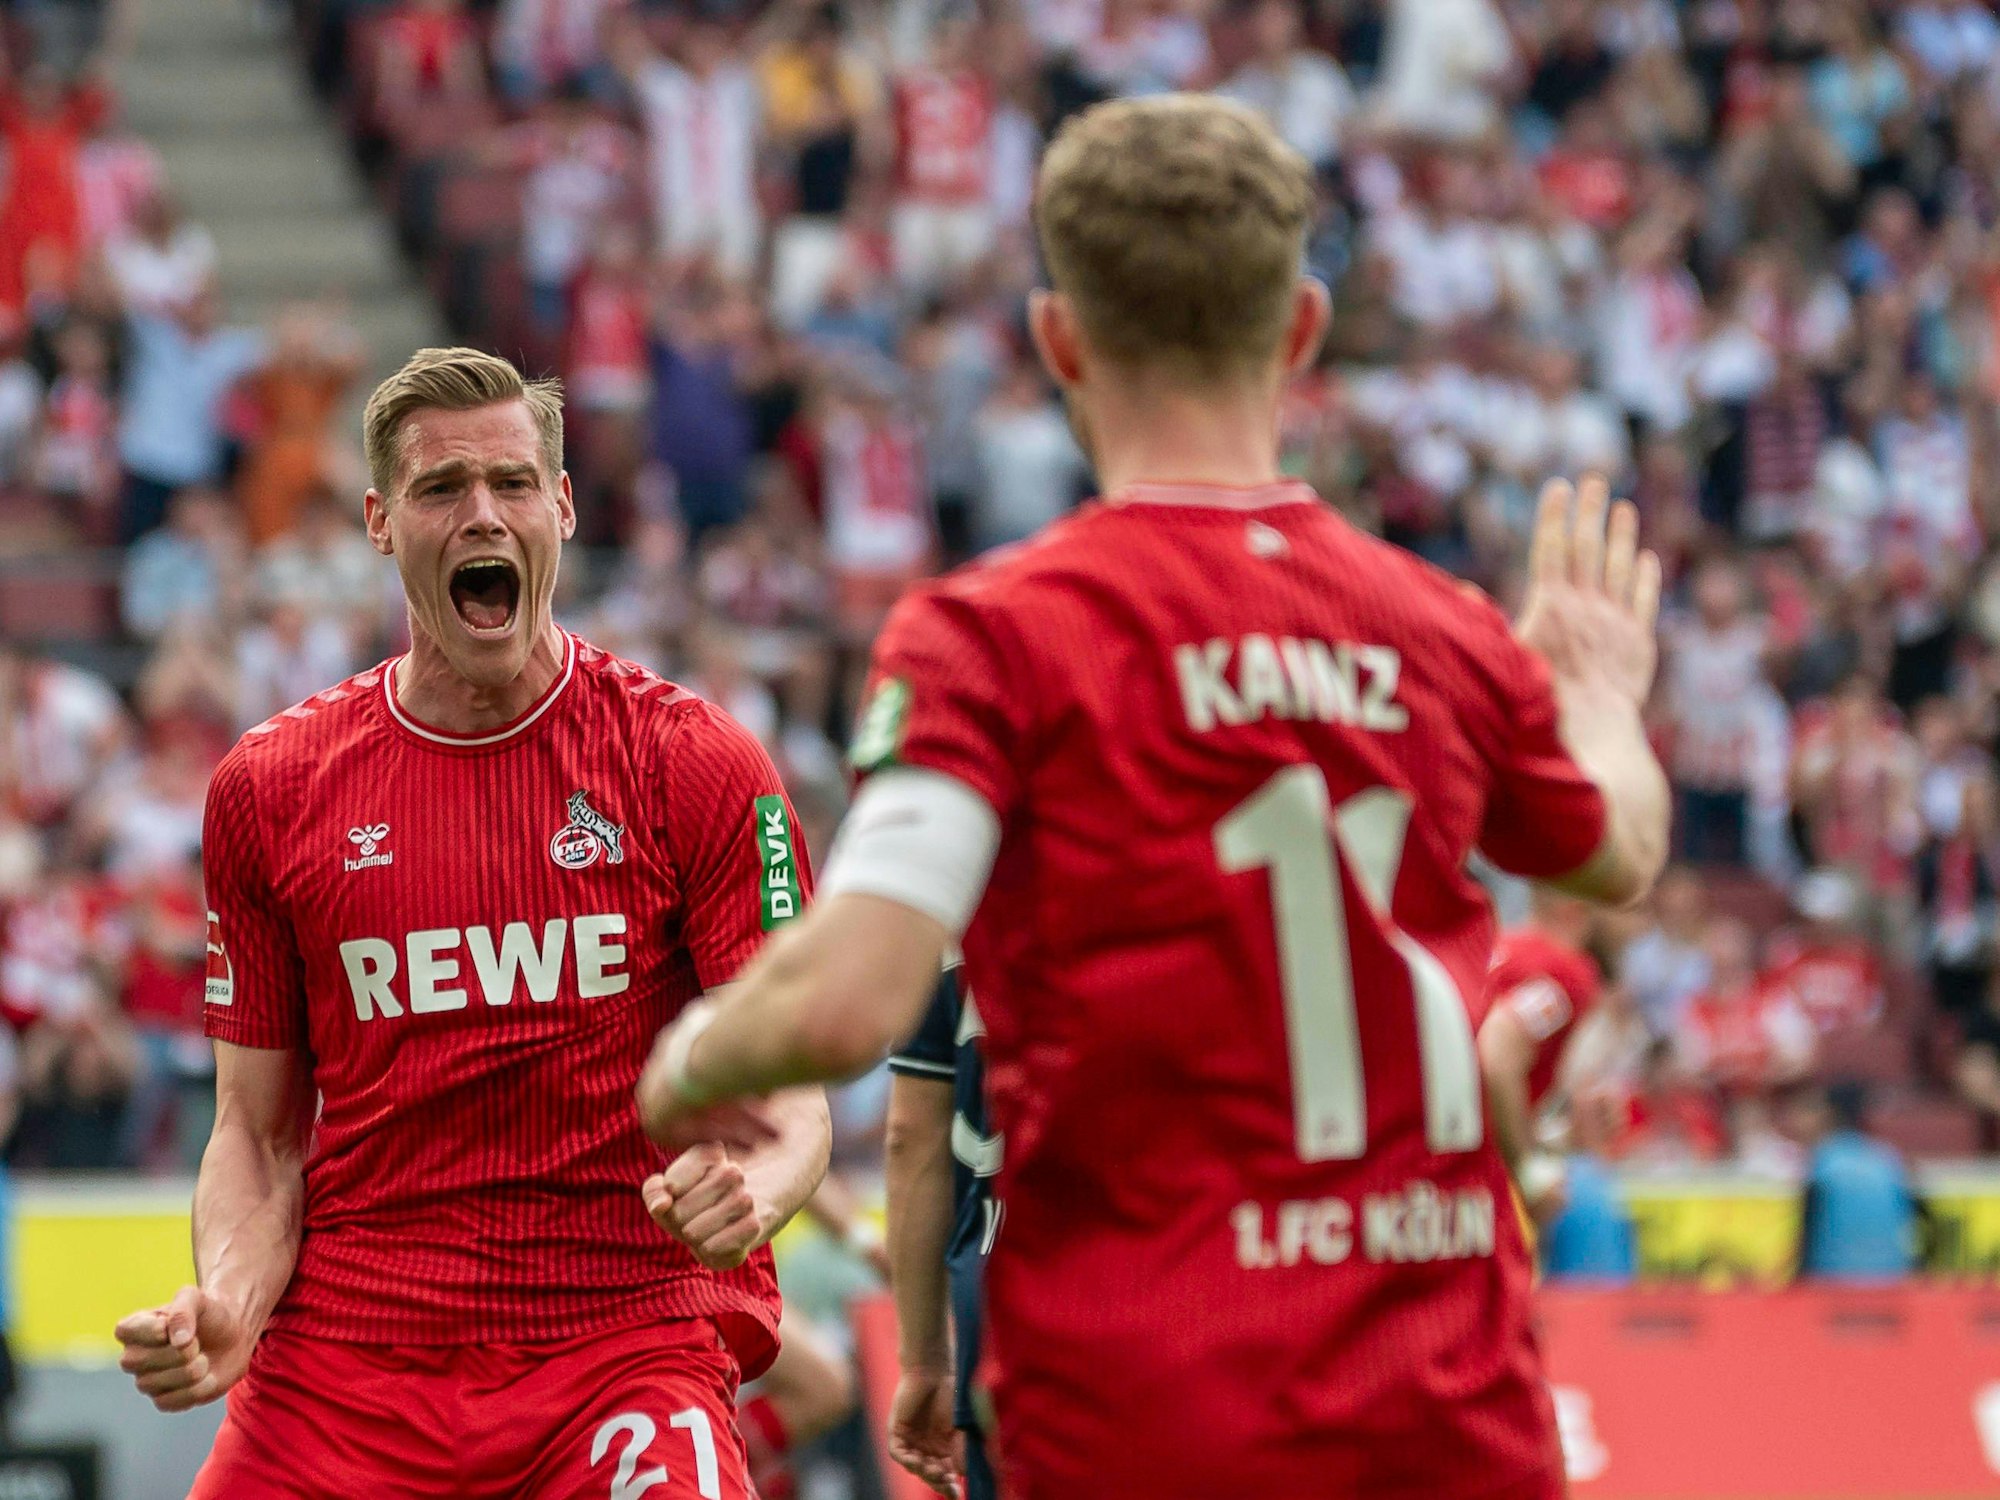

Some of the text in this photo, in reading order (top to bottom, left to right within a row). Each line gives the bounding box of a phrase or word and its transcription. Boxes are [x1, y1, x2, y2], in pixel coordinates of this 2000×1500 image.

[1174, 633, 1410, 733] KAINZ
[344, 851, 393, 871] hummel
[764, 808, 794, 918] DEVK
[339, 913, 630, 1022] REWE
[1211, 762, 1483, 1162] 11
[1229, 1178, 1496, 1269] 1.FC KÖLN
[590, 1407, 721, 1500] 21
